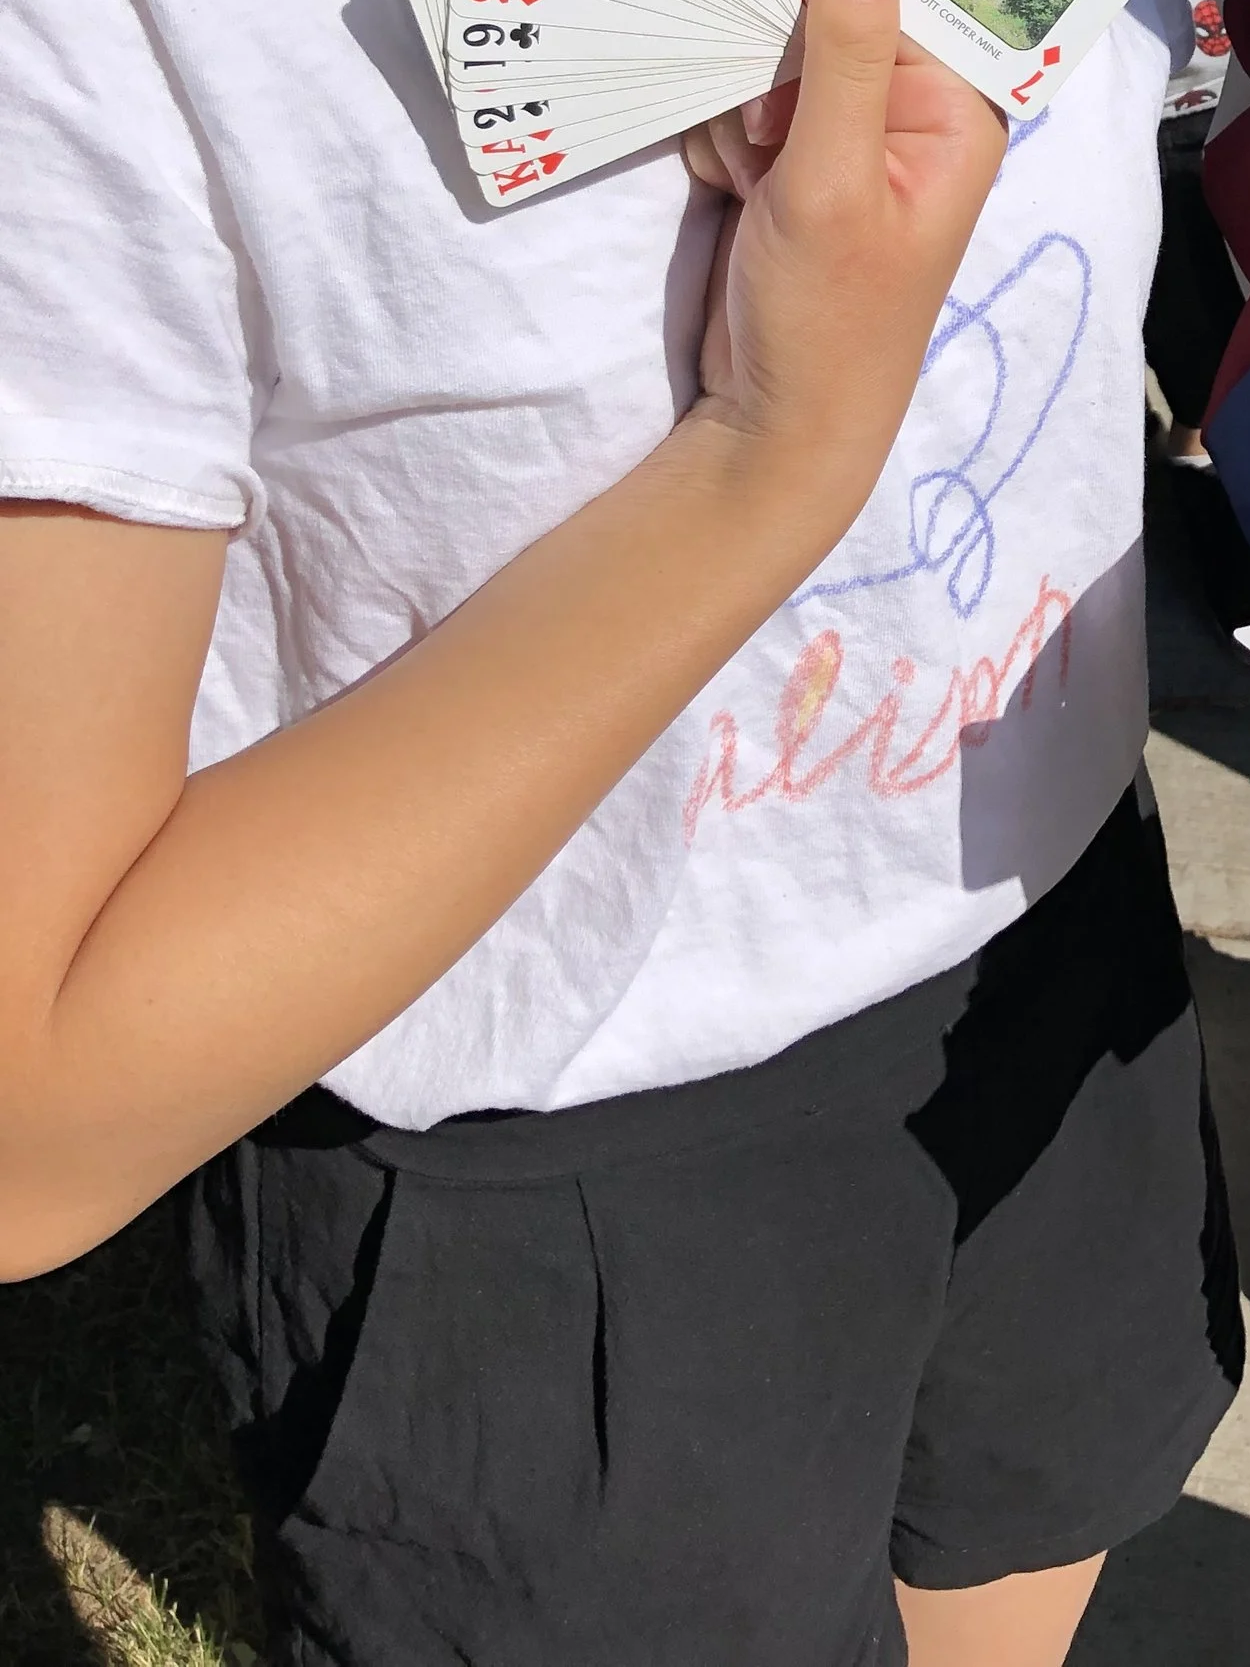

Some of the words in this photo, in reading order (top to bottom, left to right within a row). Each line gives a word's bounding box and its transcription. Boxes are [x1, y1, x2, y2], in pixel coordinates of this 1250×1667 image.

[463, 24, 505, 46] 9
[939, 8, 976, 40] COPPER
[975, 36, 1003, 60] MINE
[1011, 69, 1044, 105] 7
[473, 105, 517, 130] 2
[497, 160, 541, 196] K
